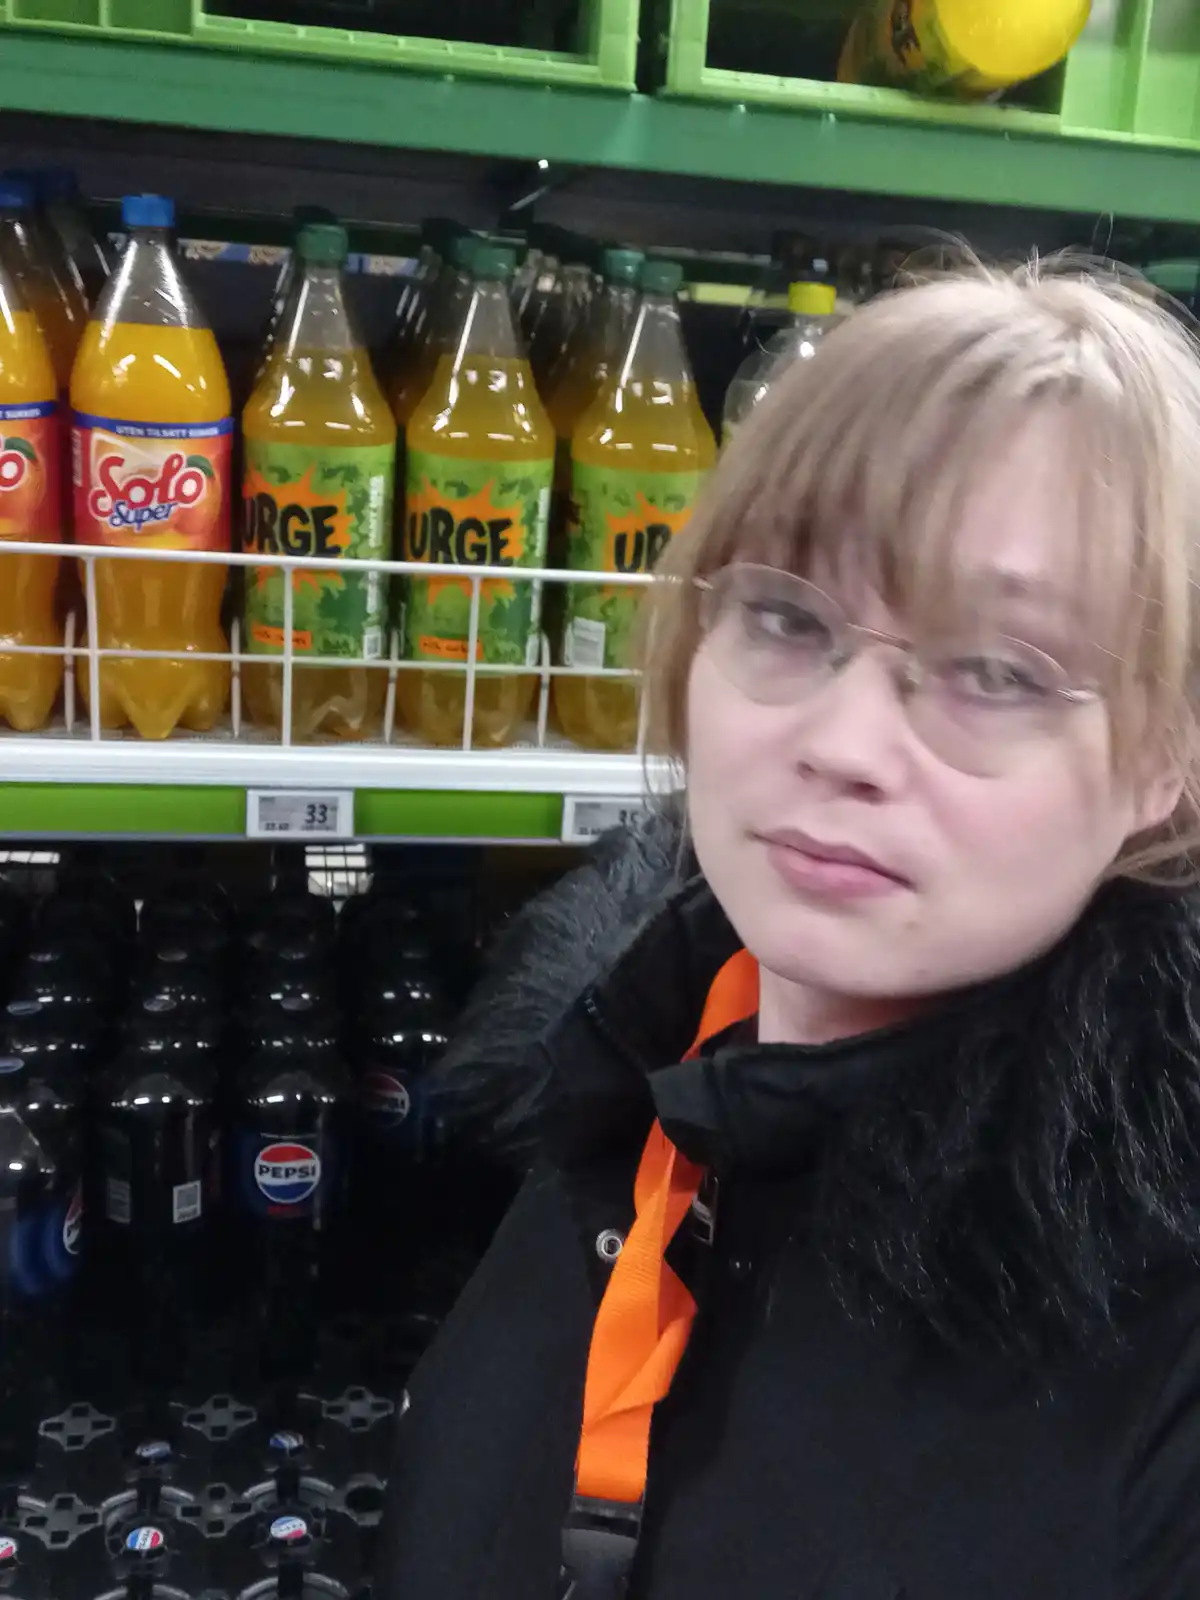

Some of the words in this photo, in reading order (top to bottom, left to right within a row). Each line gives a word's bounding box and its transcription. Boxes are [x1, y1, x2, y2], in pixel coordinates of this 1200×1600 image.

[89, 452, 207, 521] Solo
[109, 500, 178, 532] Super
[243, 492, 341, 557] URGE
[408, 507, 514, 567] URGE
[613, 523, 672, 573] UR
[305, 803, 328, 824] 33
[258, 1163, 316, 1180] PEPSI
